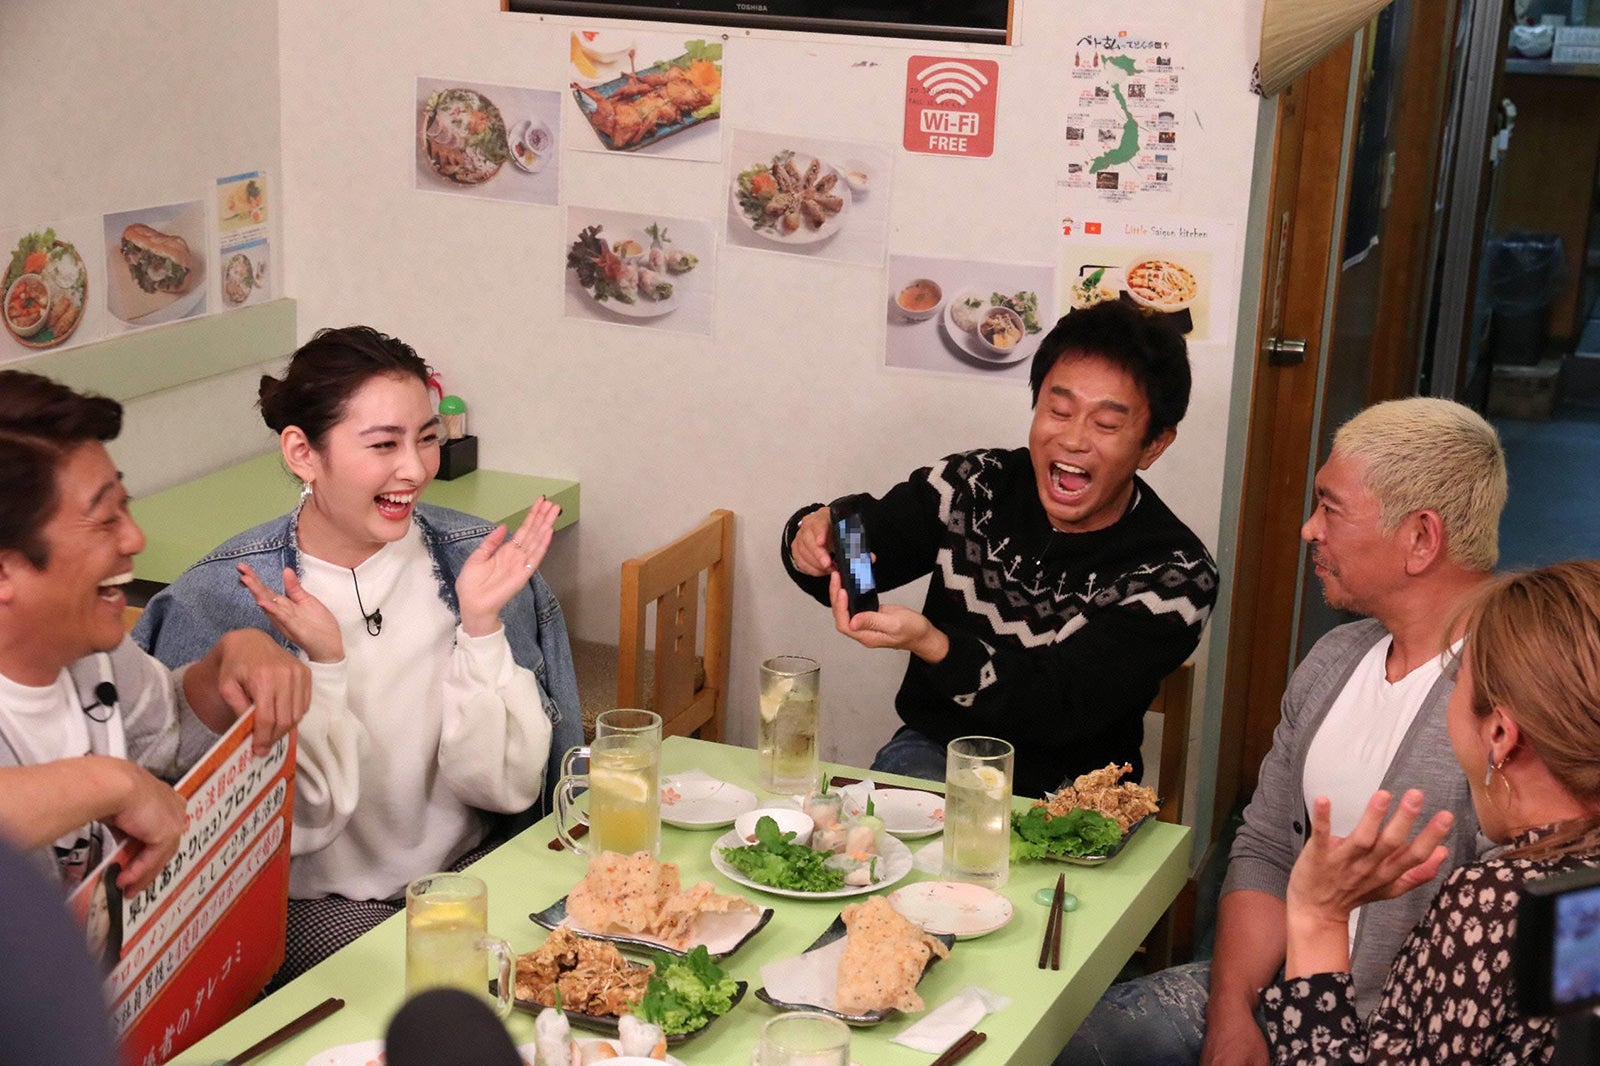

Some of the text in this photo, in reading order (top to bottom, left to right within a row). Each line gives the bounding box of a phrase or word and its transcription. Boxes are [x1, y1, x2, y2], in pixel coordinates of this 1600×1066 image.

[736, 3, 768, 11] TOSHIBA
[923, 111, 977, 134] Wi-Fi
[929, 135, 968, 152] FREE
[1125, 224, 1147, 235] Little
[1151, 226, 1175, 238] Saigon
[183, 748, 254, 833] から注目の若
